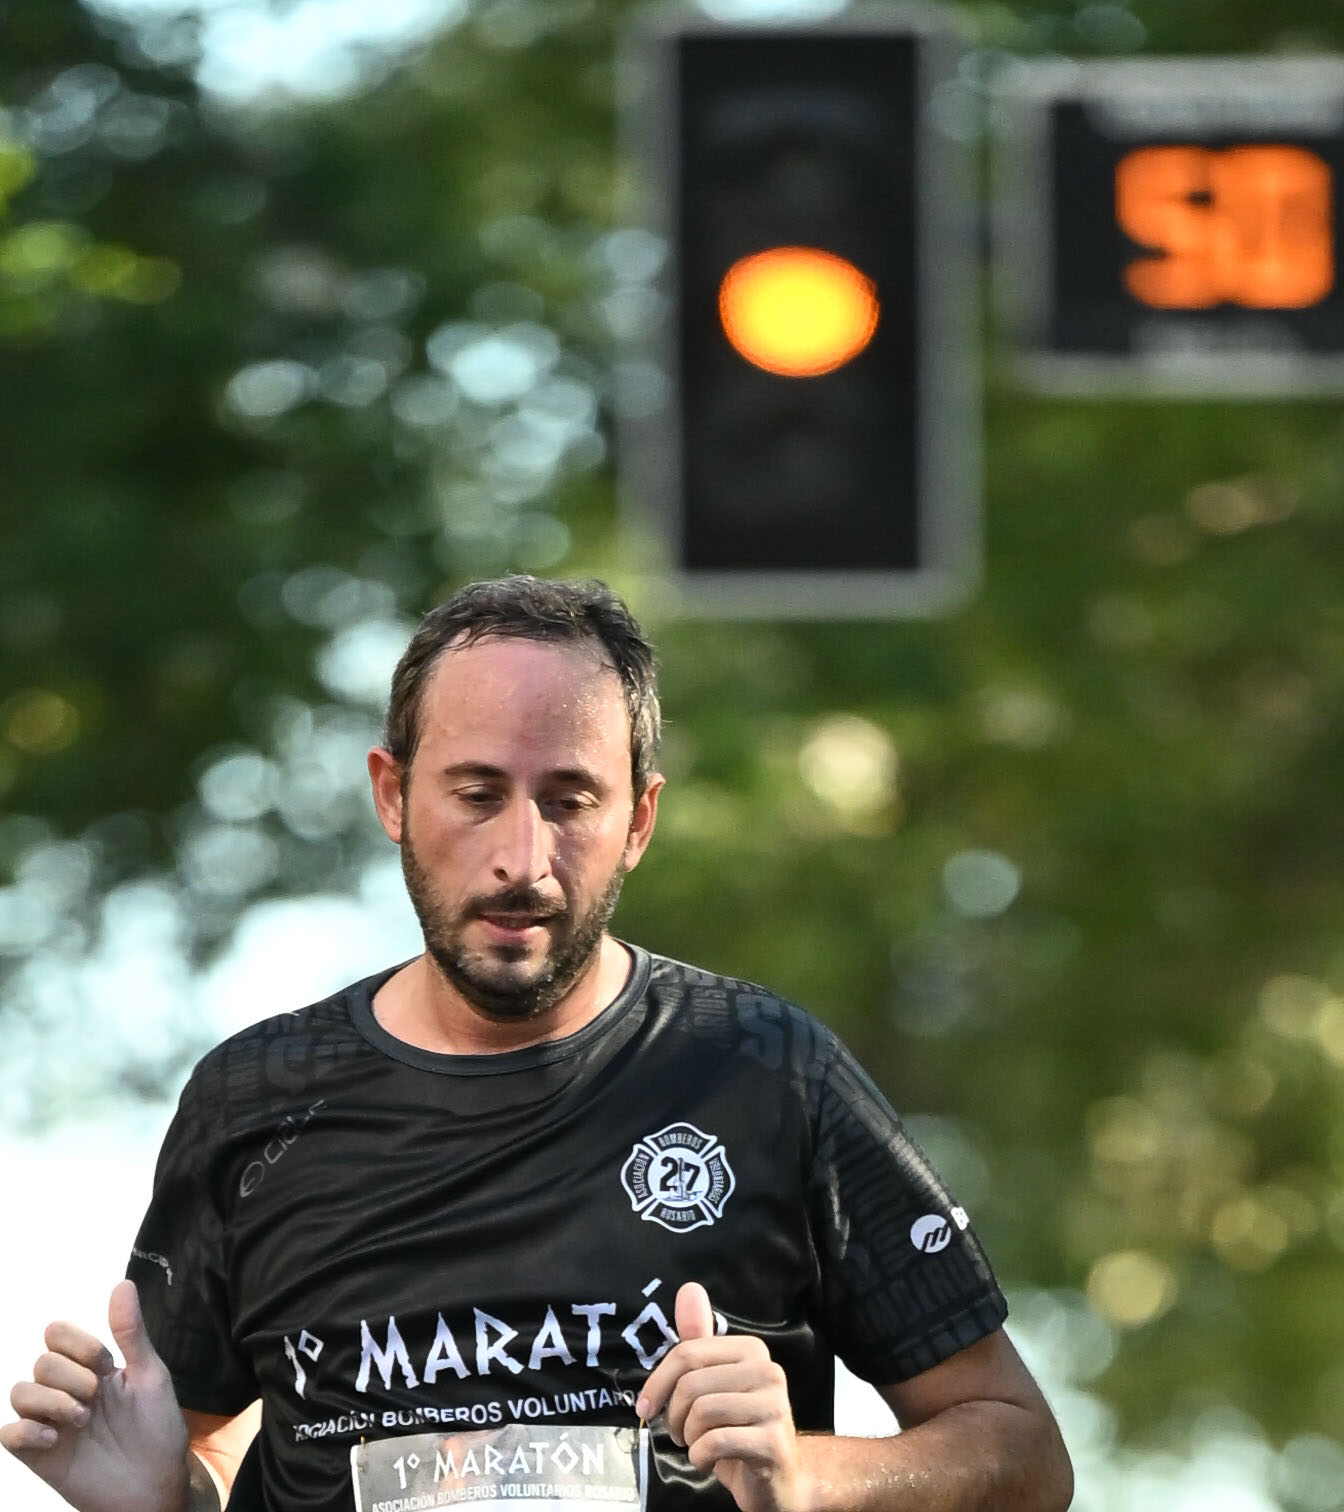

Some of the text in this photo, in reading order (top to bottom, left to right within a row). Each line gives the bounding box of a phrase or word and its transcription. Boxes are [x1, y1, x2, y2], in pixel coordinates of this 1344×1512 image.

[659, 1156, 701, 1192] 27
[355, 1277, 727, 1393] MARATÓ
[382, 1400, 502, 1427] BOMBEROS
[433, 1432, 605, 1483] MARATÓN
[437, 1483, 498, 1505] BOMBEROS
